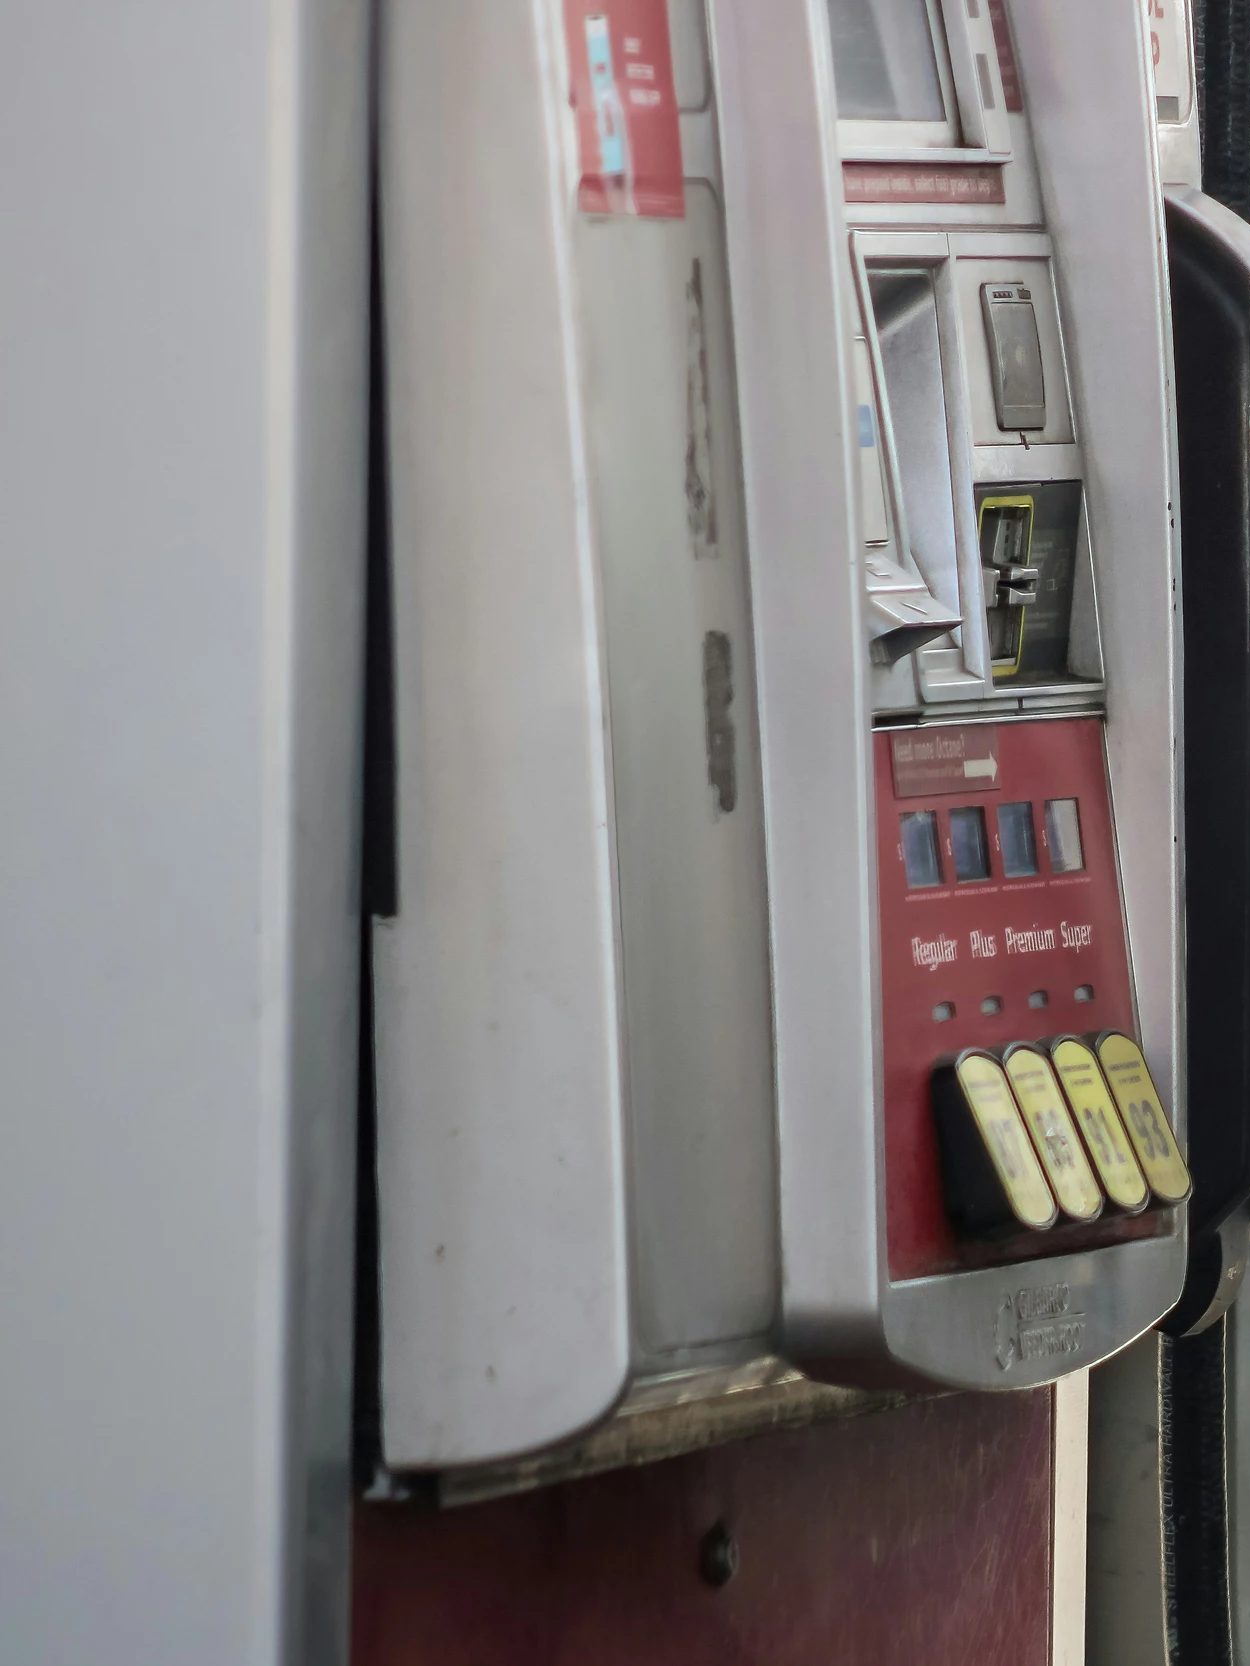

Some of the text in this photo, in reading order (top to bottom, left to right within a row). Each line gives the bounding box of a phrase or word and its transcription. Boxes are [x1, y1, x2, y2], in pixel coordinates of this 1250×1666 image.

[911, 921, 1092, 971] Regular Plus Premium Super
[1128, 1100, 1170, 1161] 93
[1161, 1453, 1174, 1508] ULTRA
